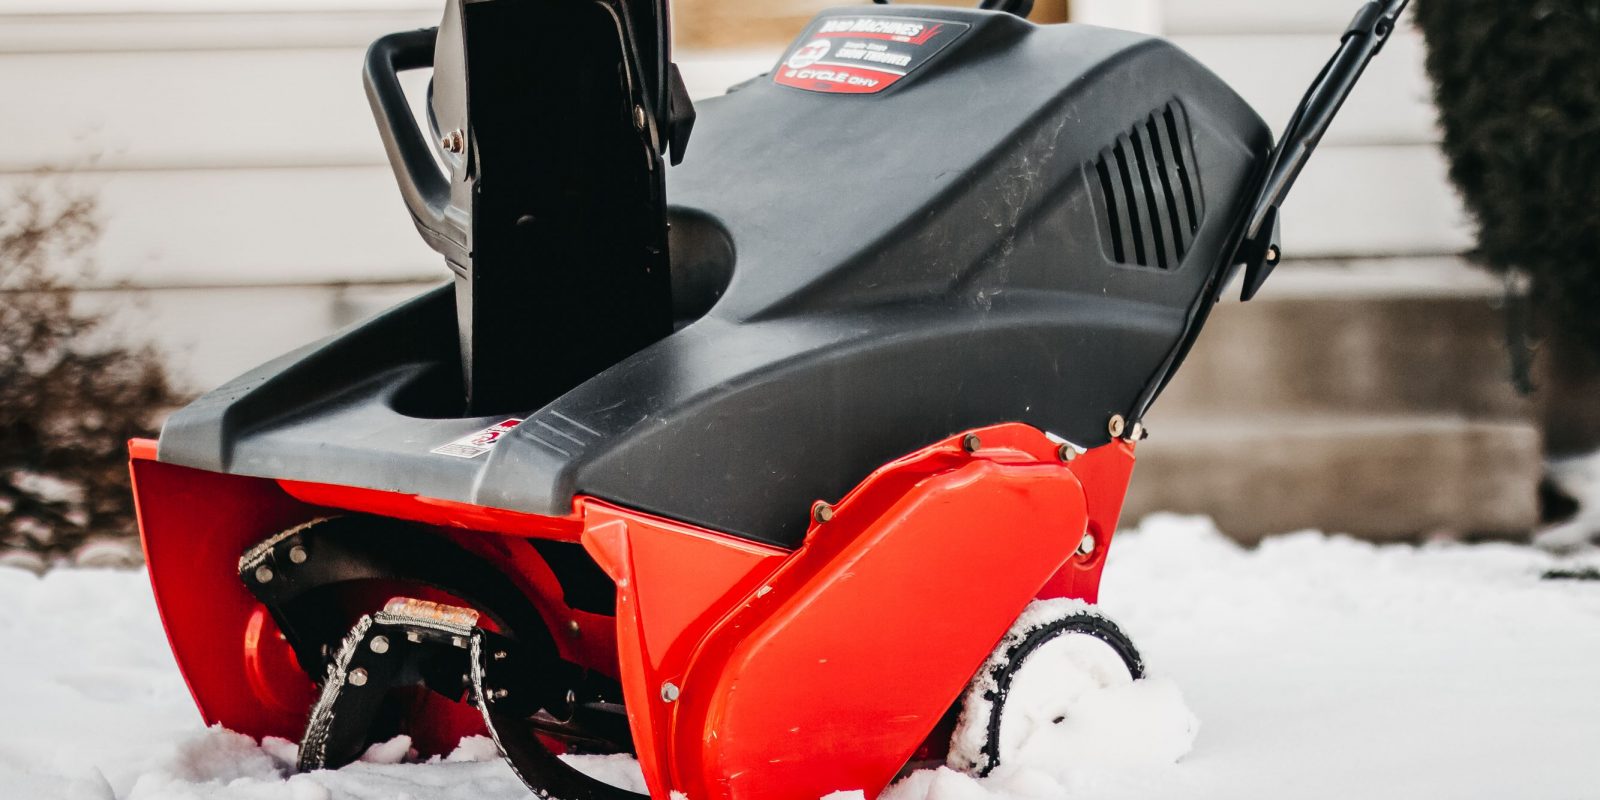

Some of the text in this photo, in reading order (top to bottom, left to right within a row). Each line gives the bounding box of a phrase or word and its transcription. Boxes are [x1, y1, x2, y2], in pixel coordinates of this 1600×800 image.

[850, 19, 923, 37] MACHINES
[797, 70, 849, 83] CYCLE
[848, 76, 879, 87] OHV
